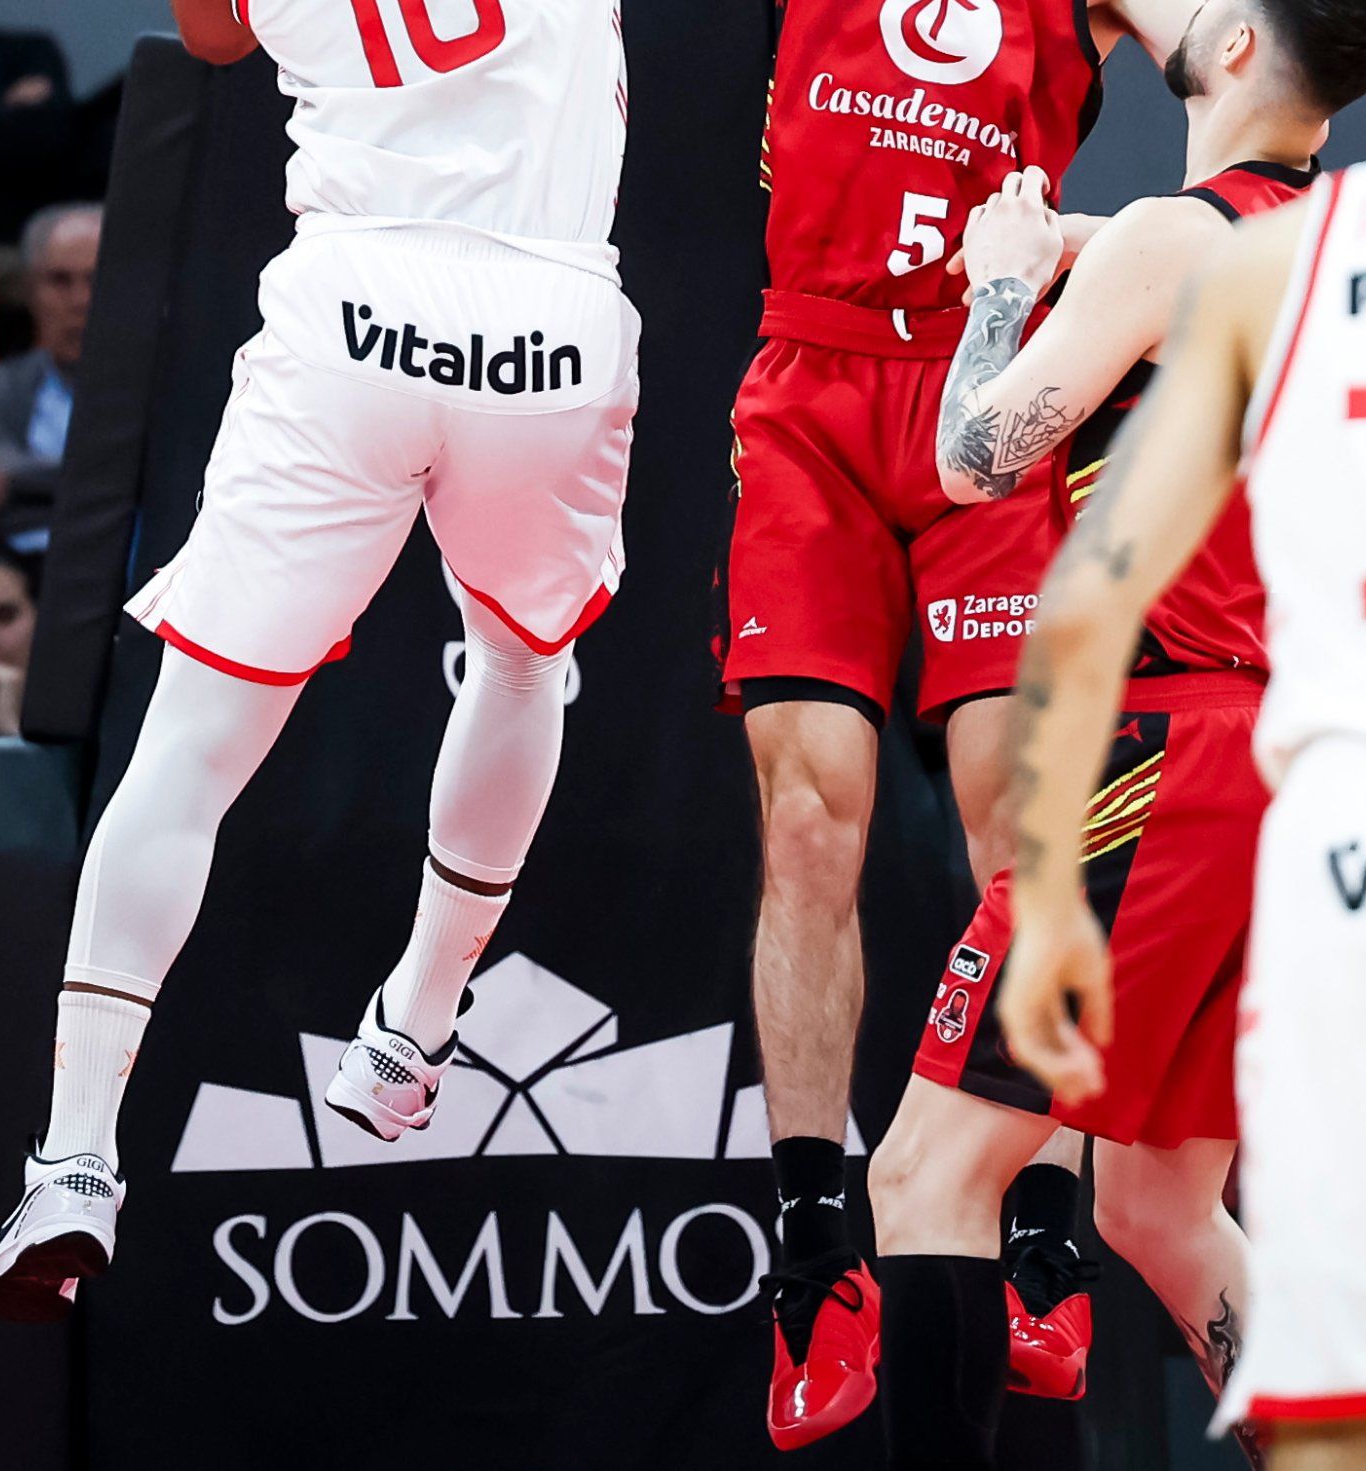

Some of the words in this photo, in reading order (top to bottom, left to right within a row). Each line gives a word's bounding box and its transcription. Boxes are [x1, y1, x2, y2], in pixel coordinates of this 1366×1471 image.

[870, 126, 972, 166] ZARAGOZA
[887, 191, 950, 276] 5
[963, 594, 1042, 617] Zarago
[955, 958, 977, 975] acb
[388, 1038, 416, 1060] GIGI
[76, 1157, 105, 1173] GIGI
[211, 1203, 782, 1326] SOMMO
